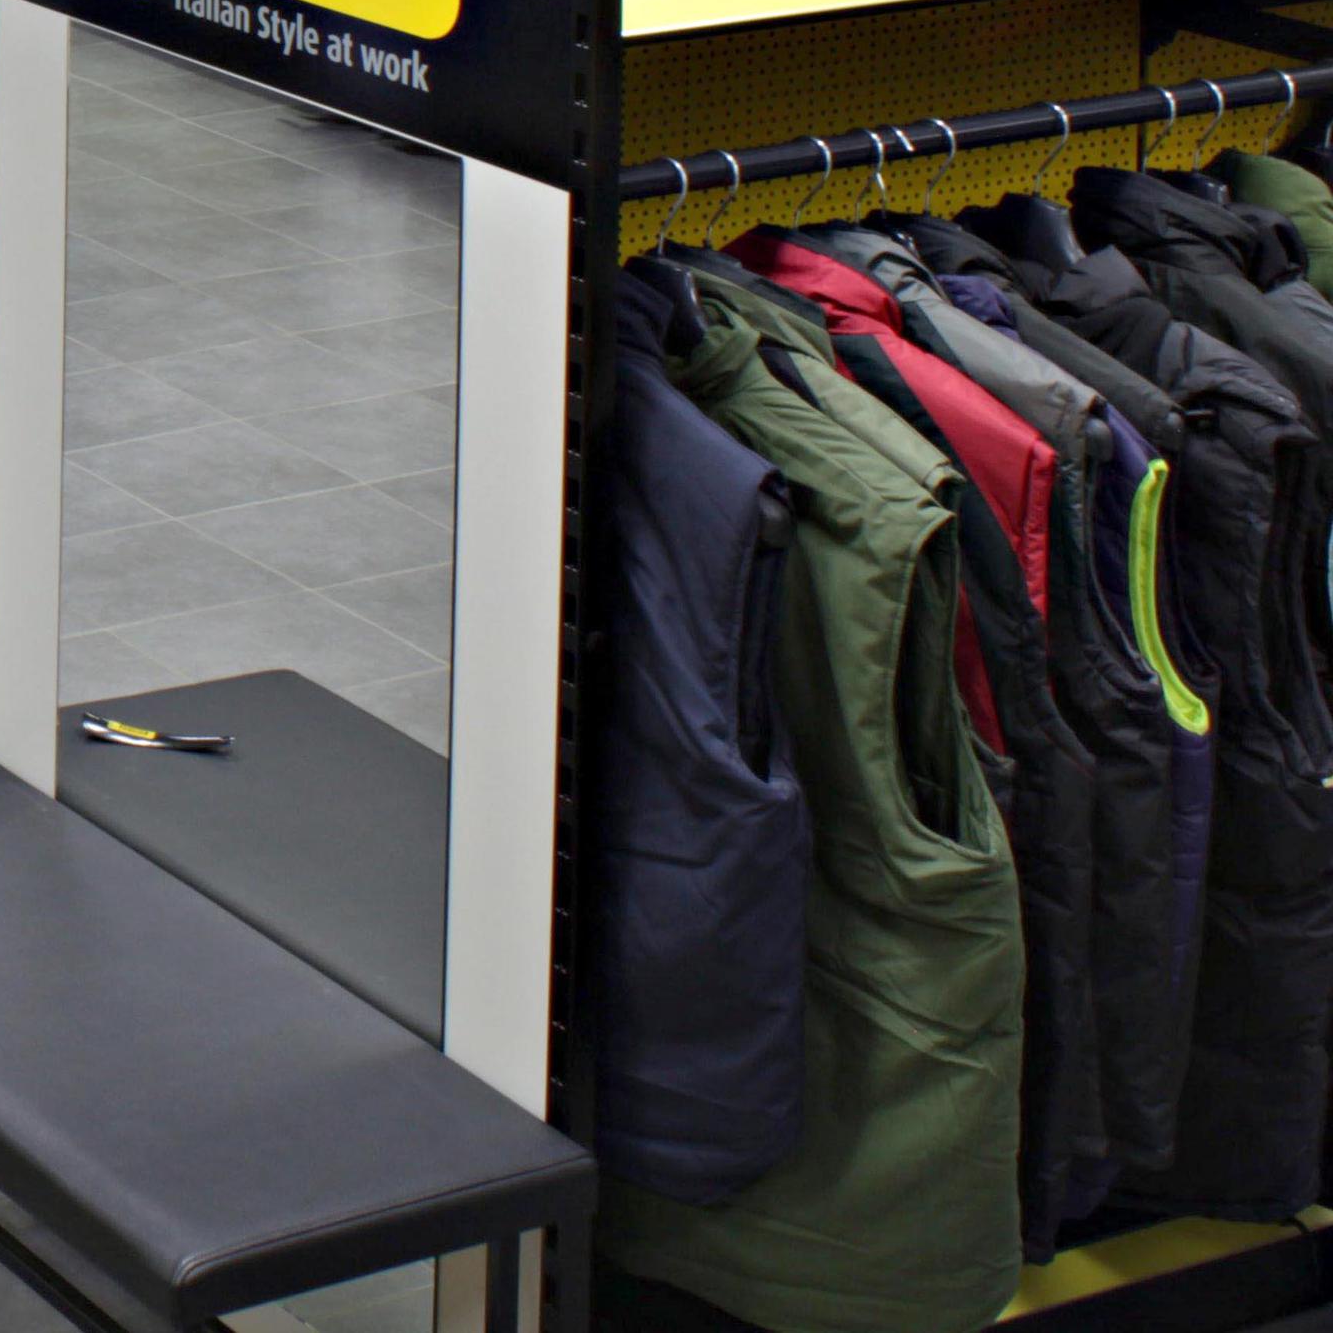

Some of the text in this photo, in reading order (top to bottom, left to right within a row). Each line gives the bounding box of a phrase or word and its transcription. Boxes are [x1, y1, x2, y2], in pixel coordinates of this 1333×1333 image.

[257, 6, 320, 56] Style
[326, 34, 353, 67] at
[360, 49, 430, 93] work
